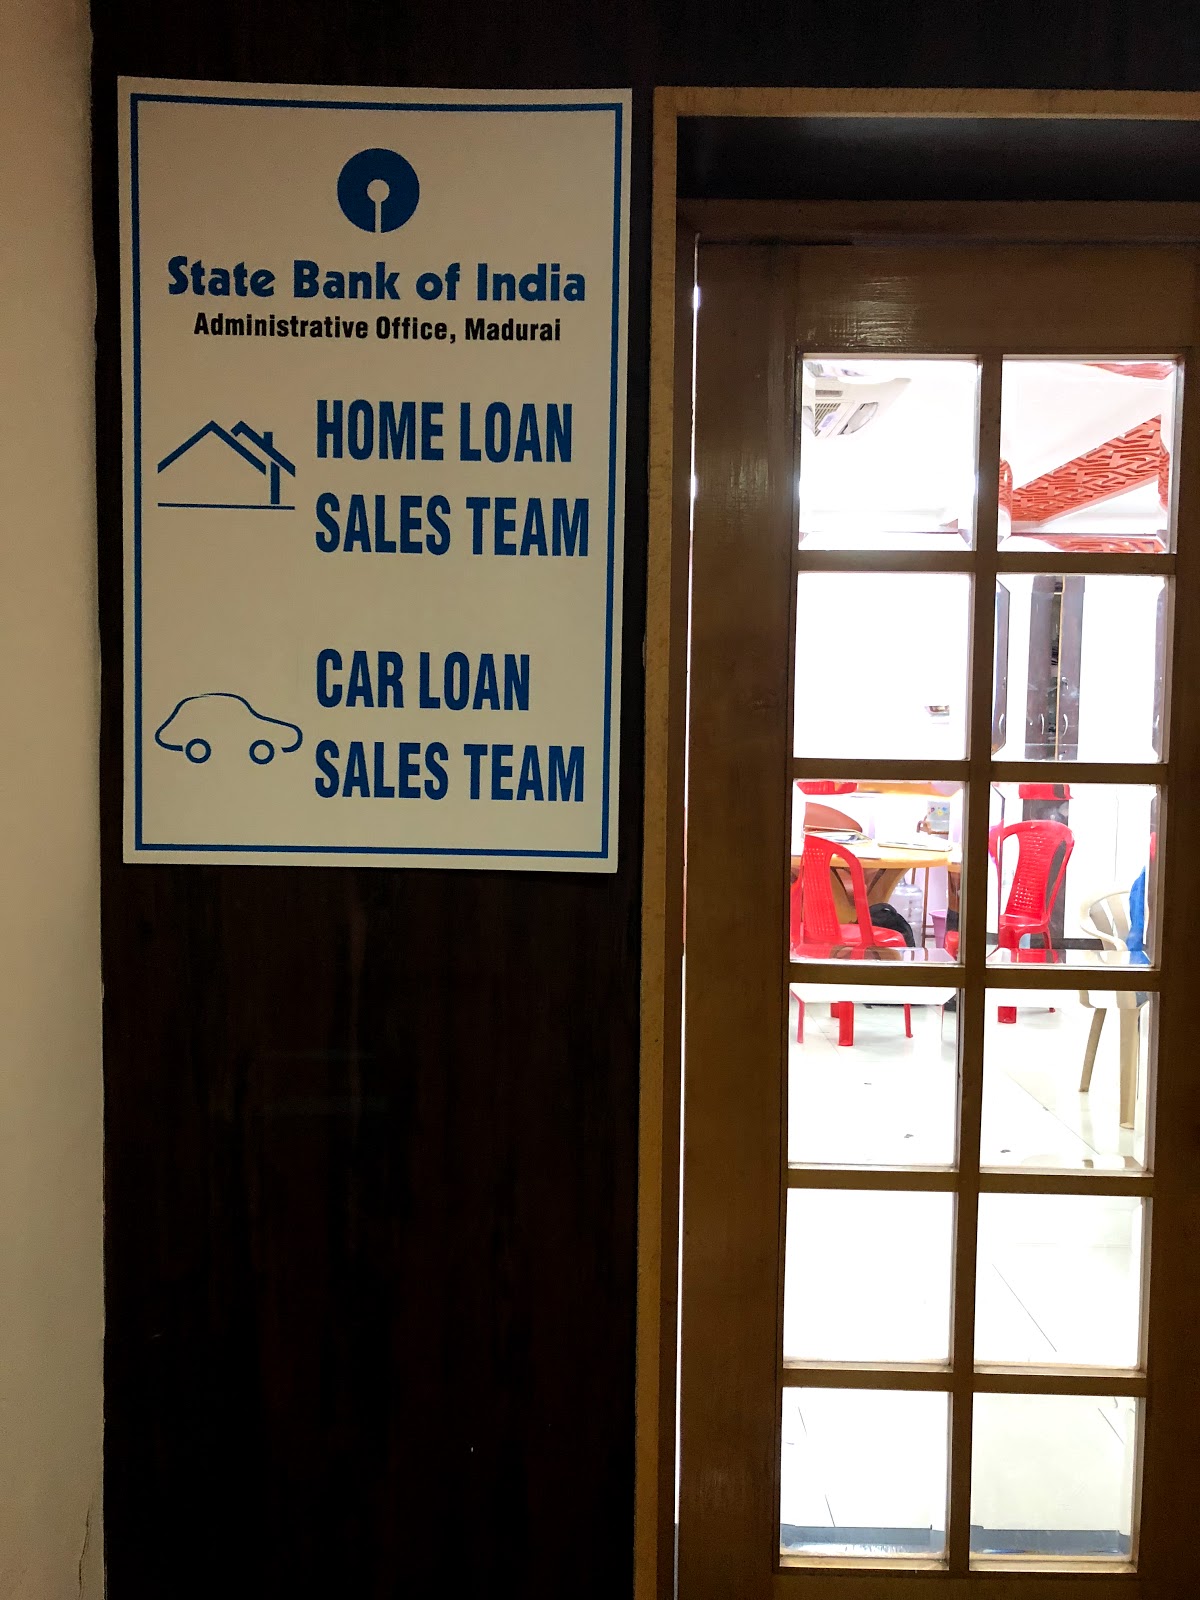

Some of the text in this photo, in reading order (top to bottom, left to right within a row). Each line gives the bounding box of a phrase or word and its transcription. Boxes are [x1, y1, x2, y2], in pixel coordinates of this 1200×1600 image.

[168, 256, 586, 302] State Bank of India
[193, 312, 561, 345] Administrative Office, Madurai
[316, 399, 573, 463] HOME LOAN
[315, 492, 589, 558] SALES TEAM
[316, 648, 531, 711] CAR LOAN
[314, 740, 585, 802] SALES TEAM
